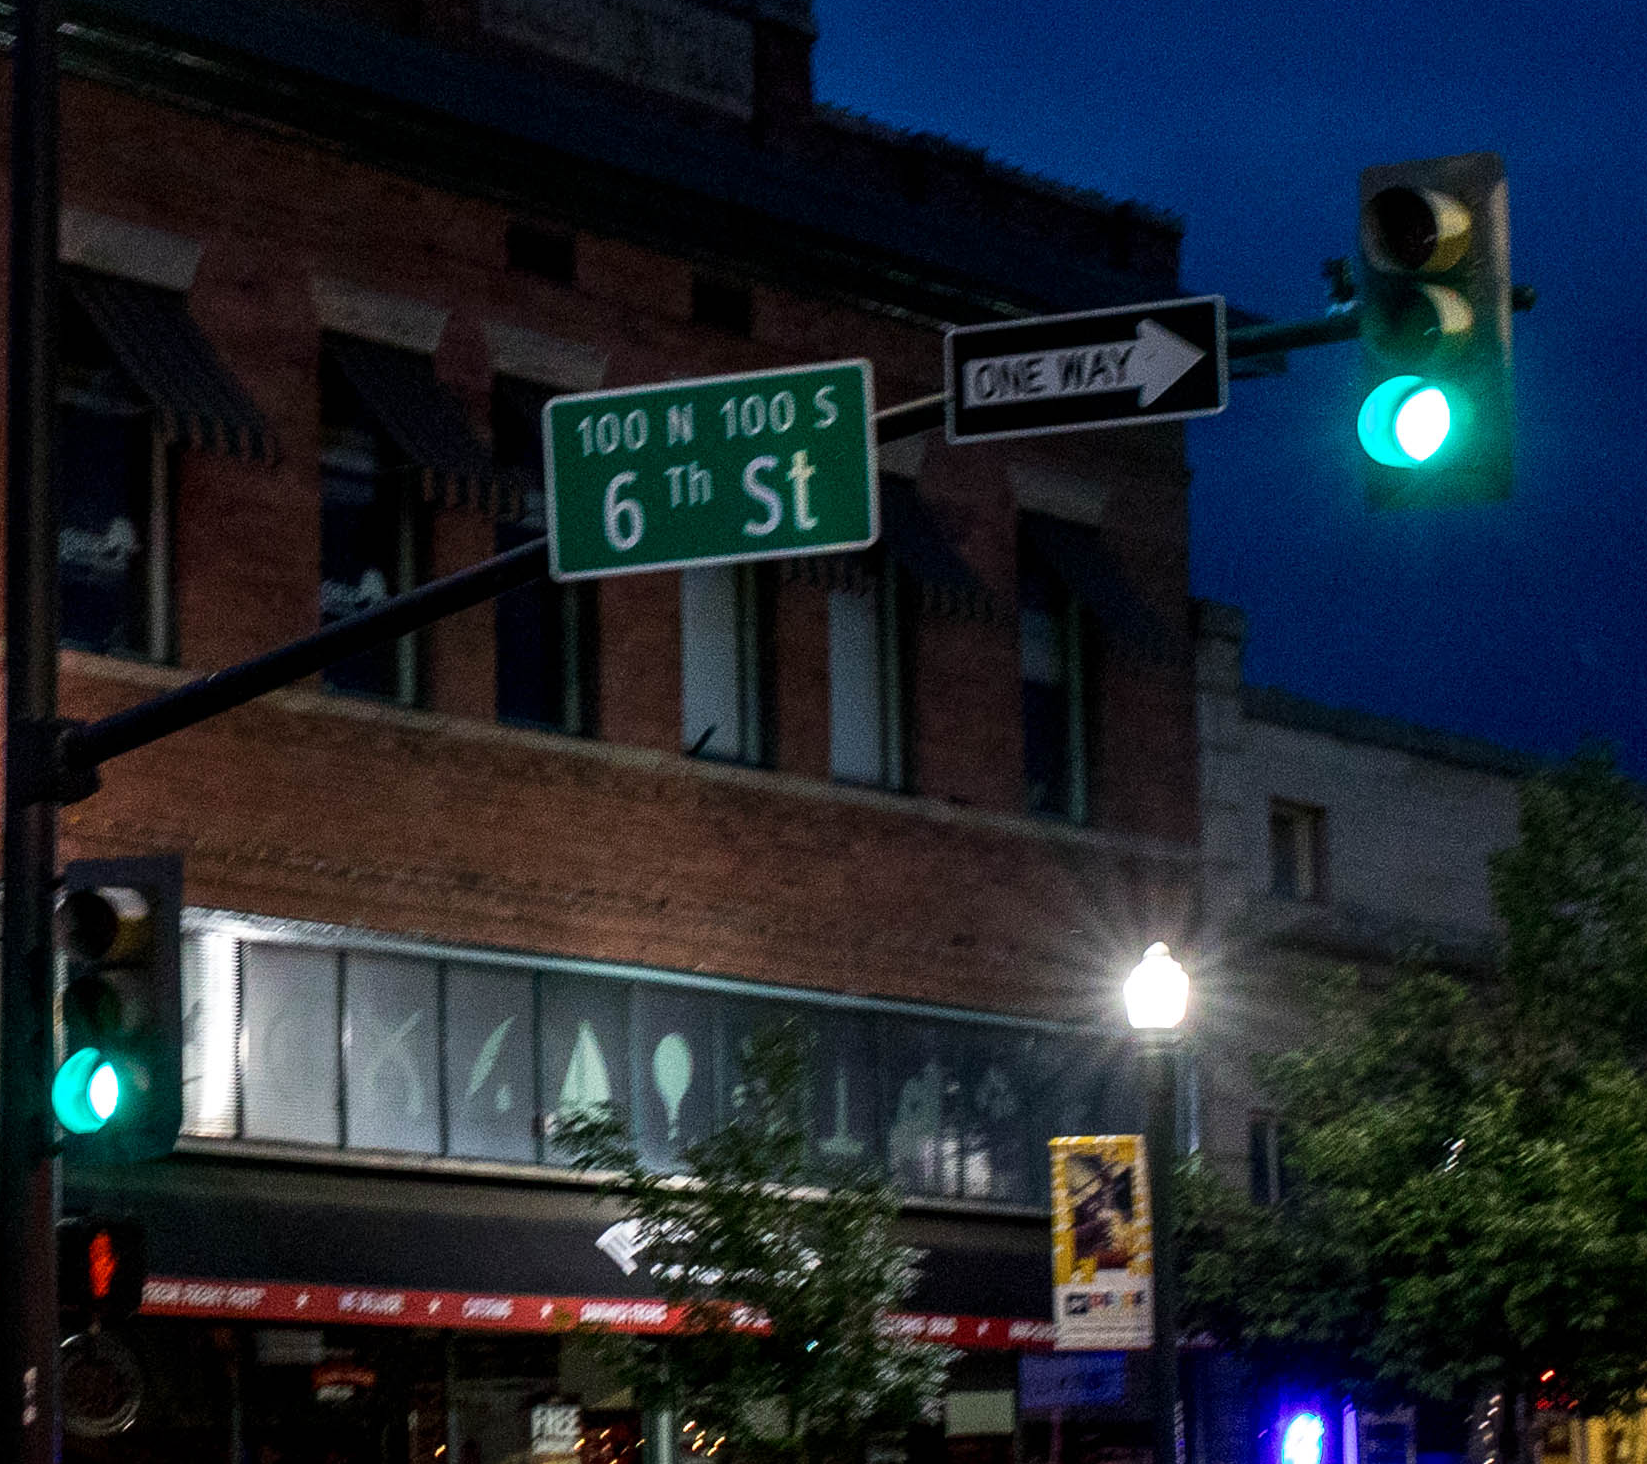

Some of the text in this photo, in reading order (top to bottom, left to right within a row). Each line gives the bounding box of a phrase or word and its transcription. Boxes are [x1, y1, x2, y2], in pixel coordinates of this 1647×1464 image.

[974, 344, 1134, 403] ONE WAY
[577, 384, 839, 458] 100 N 100 S
[602, 448, 819, 552] 6 Th St
